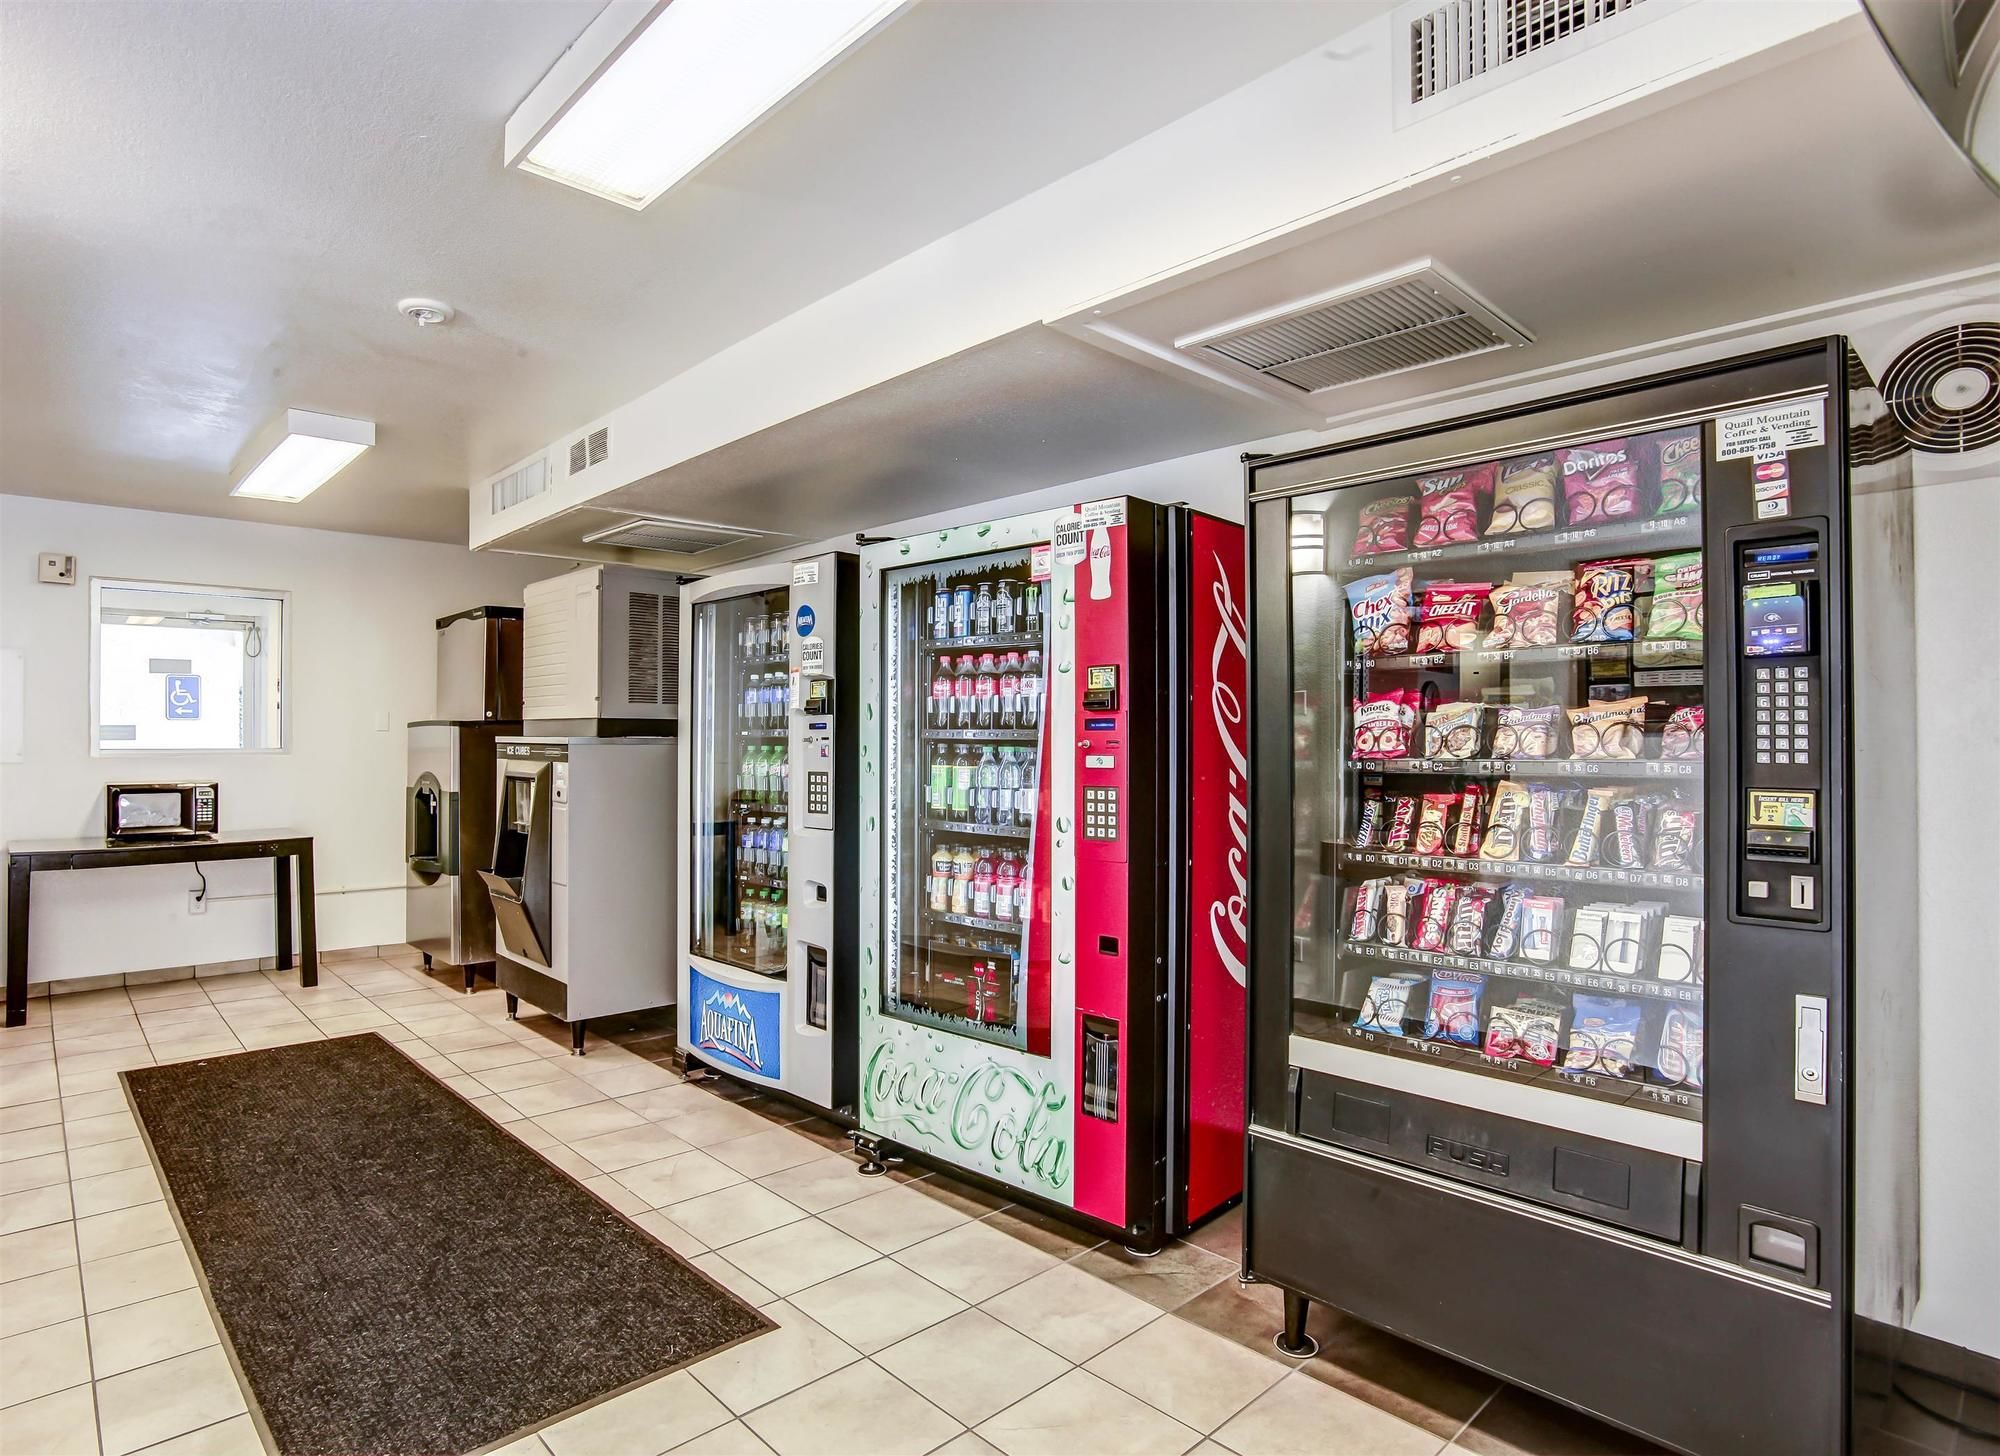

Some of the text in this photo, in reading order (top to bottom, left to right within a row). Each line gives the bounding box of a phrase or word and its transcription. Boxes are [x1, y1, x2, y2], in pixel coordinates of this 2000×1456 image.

[1724, 408, 1810, 430] Quail Mountain
[1724, 428, 1757, 439] Coffee
[1771, 419, 1811, 431] Vending
[1757, 450, 1785, 460] VISA
[1563, 450, 1627, 476] Doritos
[1422, 474, 1464, 497] Sun
[1755, 483, 1786, 493] DISCOVER
[1673, 517, 1686, 526] A8
[1056, 530, 1085, 547] COUNT
[1591, 573, 1634, 599] RITZ
[1353, 590, 1394, 619] Chex
[1674, 641, 1687, 650] B8
[802, 650, 823, 661] COUNT
[1587, 647, 1599, 655] B6
[1360, 703, 1391, 716] Knott's
[506, 746, 531, 756] ICE CUBES
[1432, 763, 1444, 771] C2
[1505, 763, 1516, 772] C4
[1586, 764, 1599, 773] C6
[1679, 765, 1692, 774] C8
[1572, 795, 1601, 862] Butterfinger
[1365, 854, 1375, 862] D0
[1432, 860, 1442, 868] D2
[1468, 862, 1479, 870] D3
[1505, 865, 1516, 873] D4
[1545, 867, 1556, 876] D5
[1586, 870, 1598, 880] D6
[1630, 873, 1642, 883] D7
[1675, 877, 1689, 887] D8
[1500, 888, 1525, 930] Almond
[1365, 948, 1375, 956] E0
[1433, 956, 1443, 965] E2
[1469, 961, 1479, 970] E3
[1507, 966, 1517, 975] E4
[1544, 972, 1555, 981] E5
[1587, 977, 1599, 987] E6
[1631, 983, 1643, 993] E7
[1679, 990, 1691, 1000] E8
[700, 1000, 764, 1068] AQUAFINA
[1431, 1046, 1441, 1055] F2
[1507, 1061, 1517, 1071] F4
[1585, 1076, 1596, 1087] F6
[1677, 1095, 1688, 1105] F8
